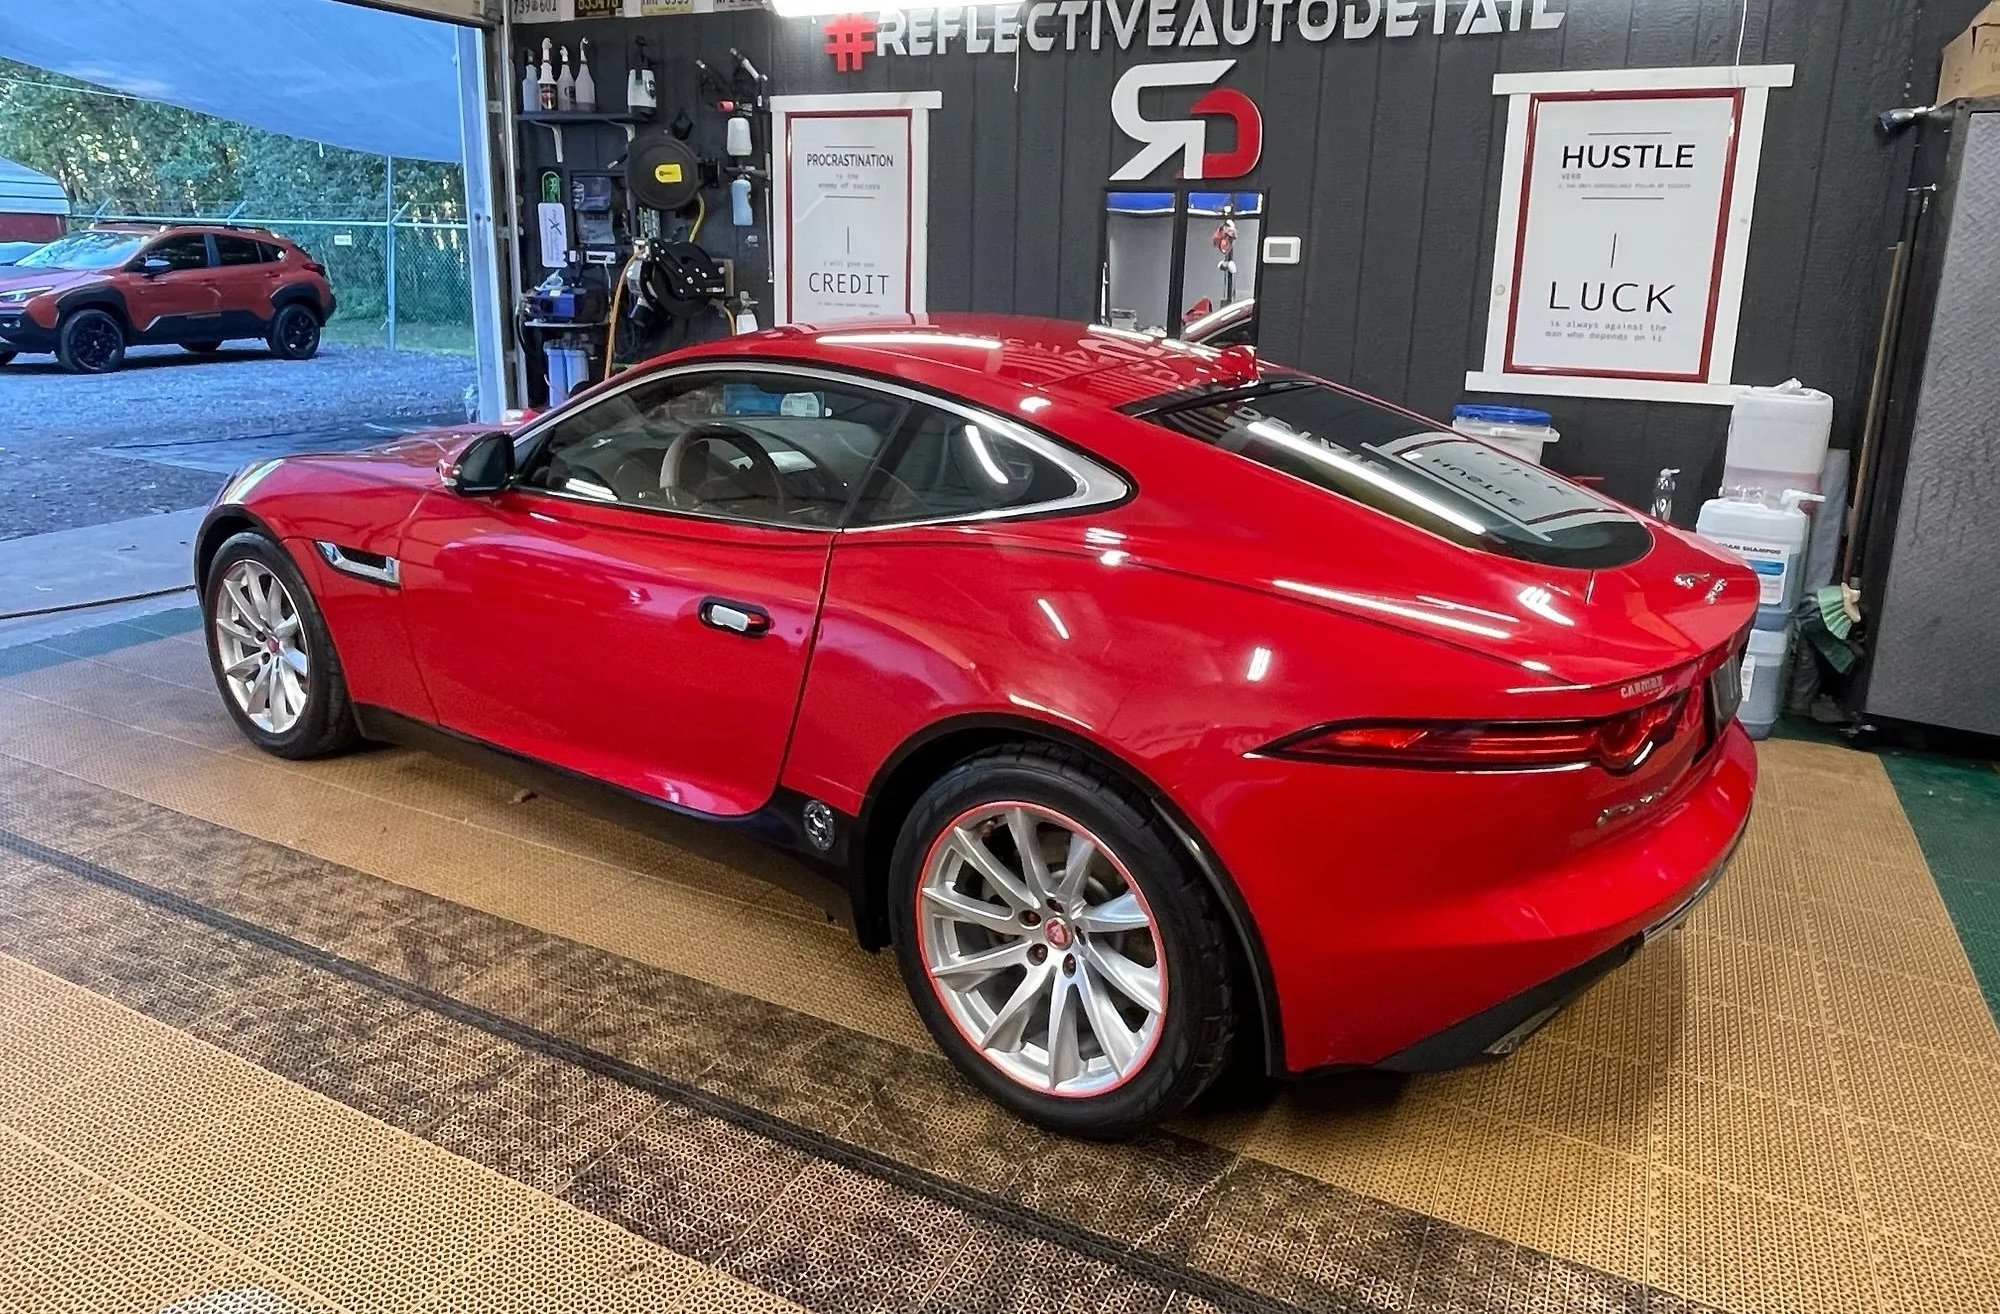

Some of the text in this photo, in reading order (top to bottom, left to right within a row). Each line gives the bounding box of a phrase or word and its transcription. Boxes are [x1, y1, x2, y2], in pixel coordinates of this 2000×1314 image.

[807, 153, 894, 167] PROCRASTINATION
[1562, 144, 1696, 169] HUSTLE
[809, 272, 889, 295] CREDIT
[1549, 281, 1676, 314] LUCK
[1551, 320, 1668, 332] is always against the
[1589, 331, 1628, 341] depends
[1742, 546, 1782, 555] SHAMPOO
